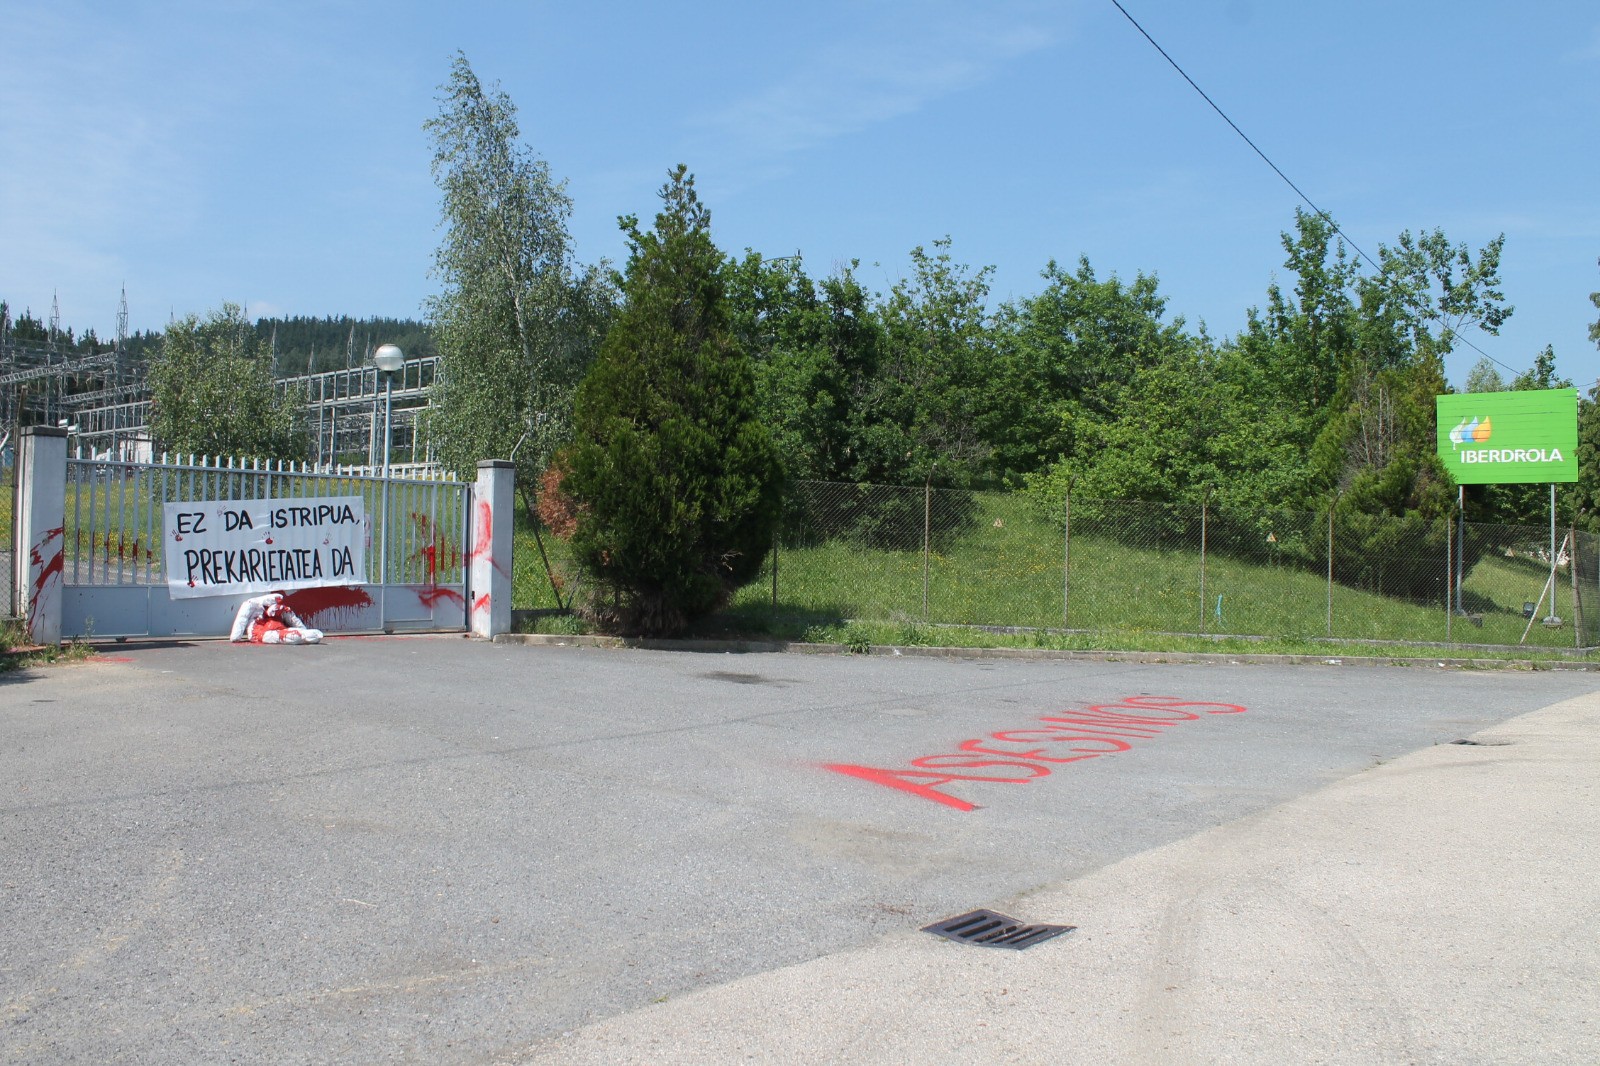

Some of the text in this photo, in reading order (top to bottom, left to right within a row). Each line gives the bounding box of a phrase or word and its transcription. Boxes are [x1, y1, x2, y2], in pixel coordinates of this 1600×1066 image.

[1460, 448, 1563, 463] IBERDROLA
[177, 504, 361, 534] EZ DA ISTRIPUA,
[184, 545, 355, 585] PREKARIETATEA DA
[821, 696, 1247, 811] ASESINOS
